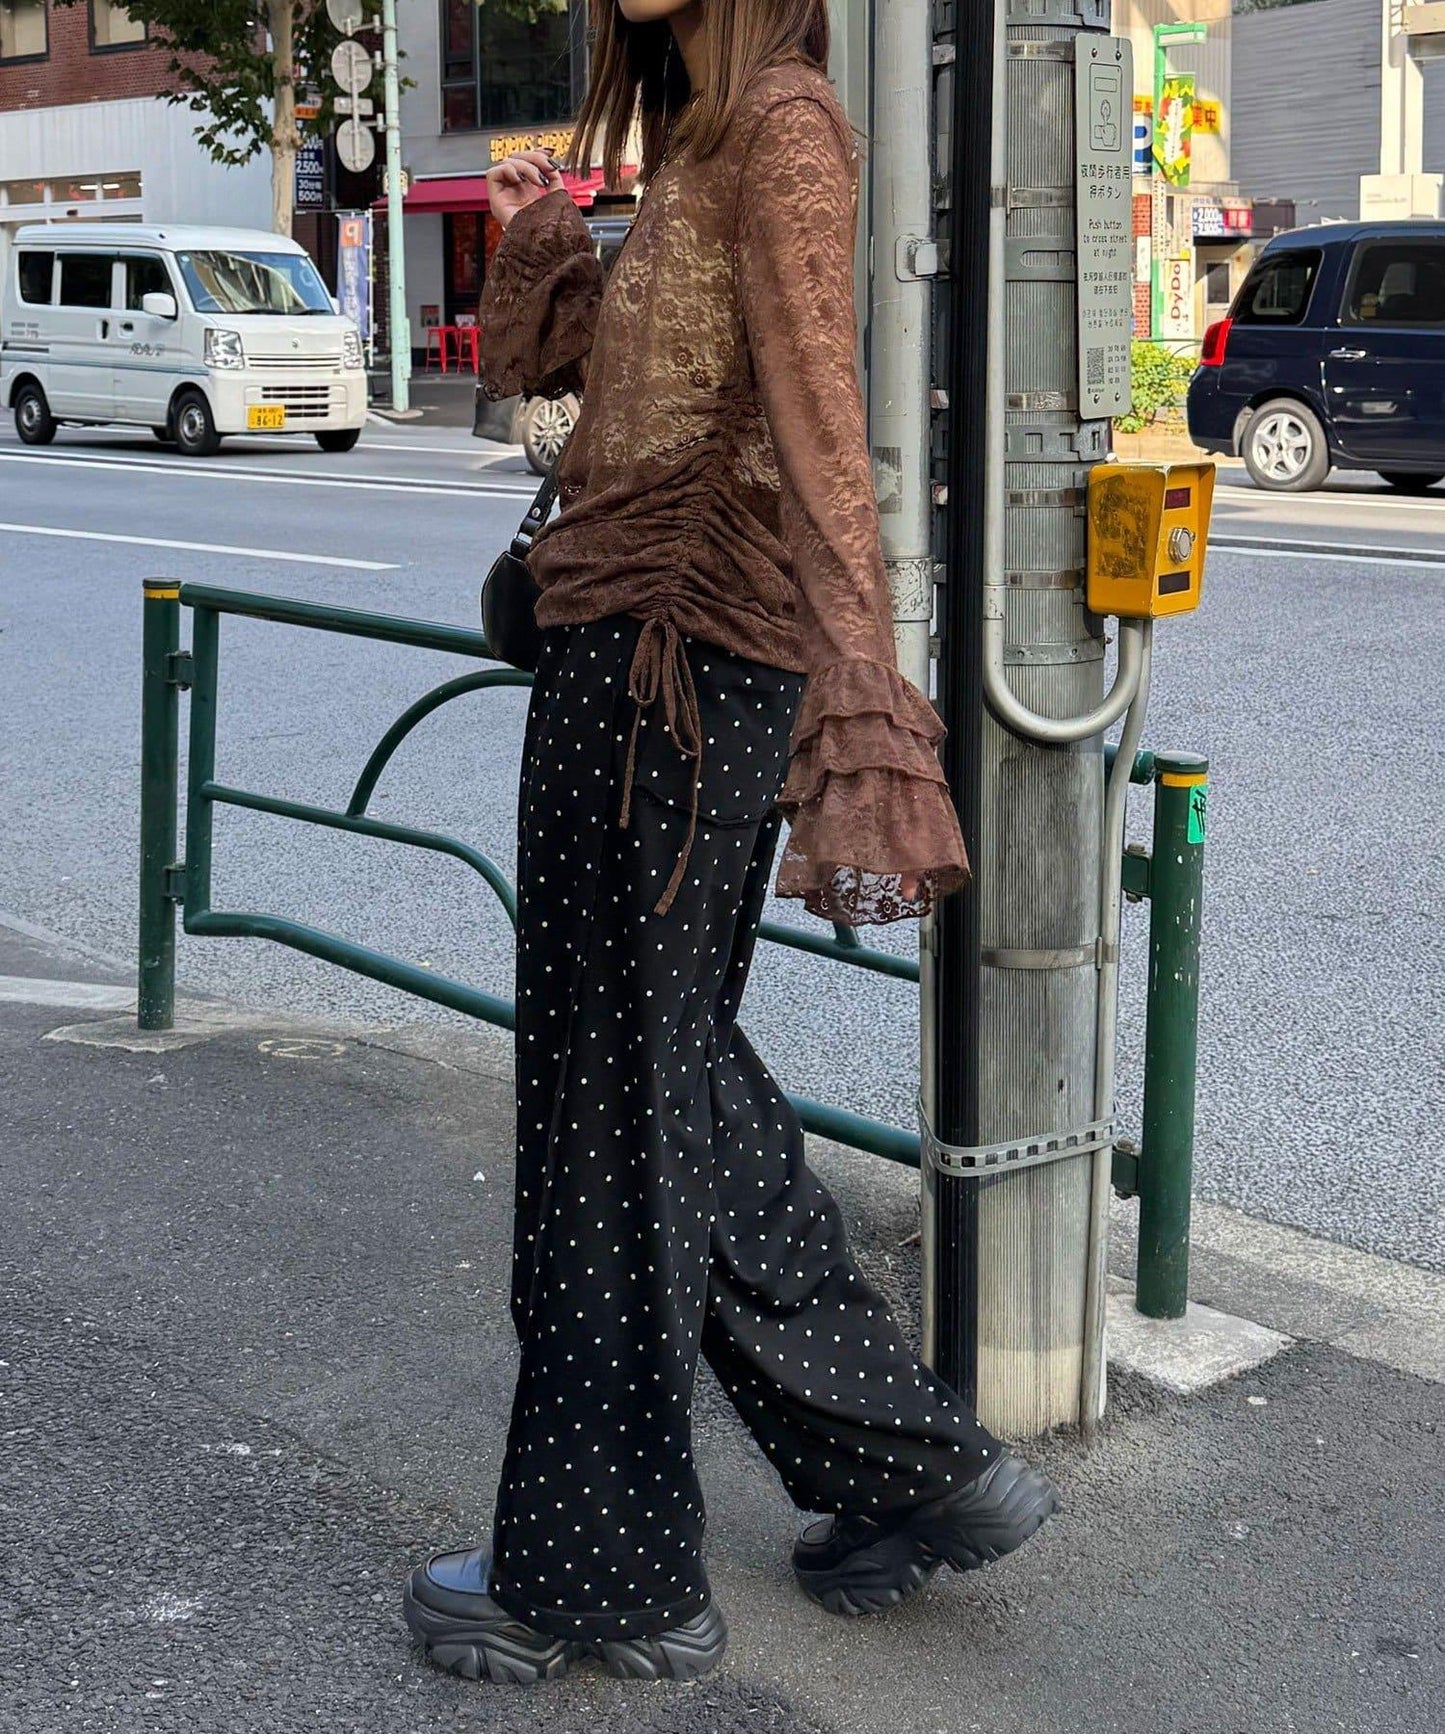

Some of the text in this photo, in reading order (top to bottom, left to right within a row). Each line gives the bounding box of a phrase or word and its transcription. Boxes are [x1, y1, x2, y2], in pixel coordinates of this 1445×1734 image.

[1089, 218, 1123, 230] Push button
[1170, 262, 1184, 320] DyDo
